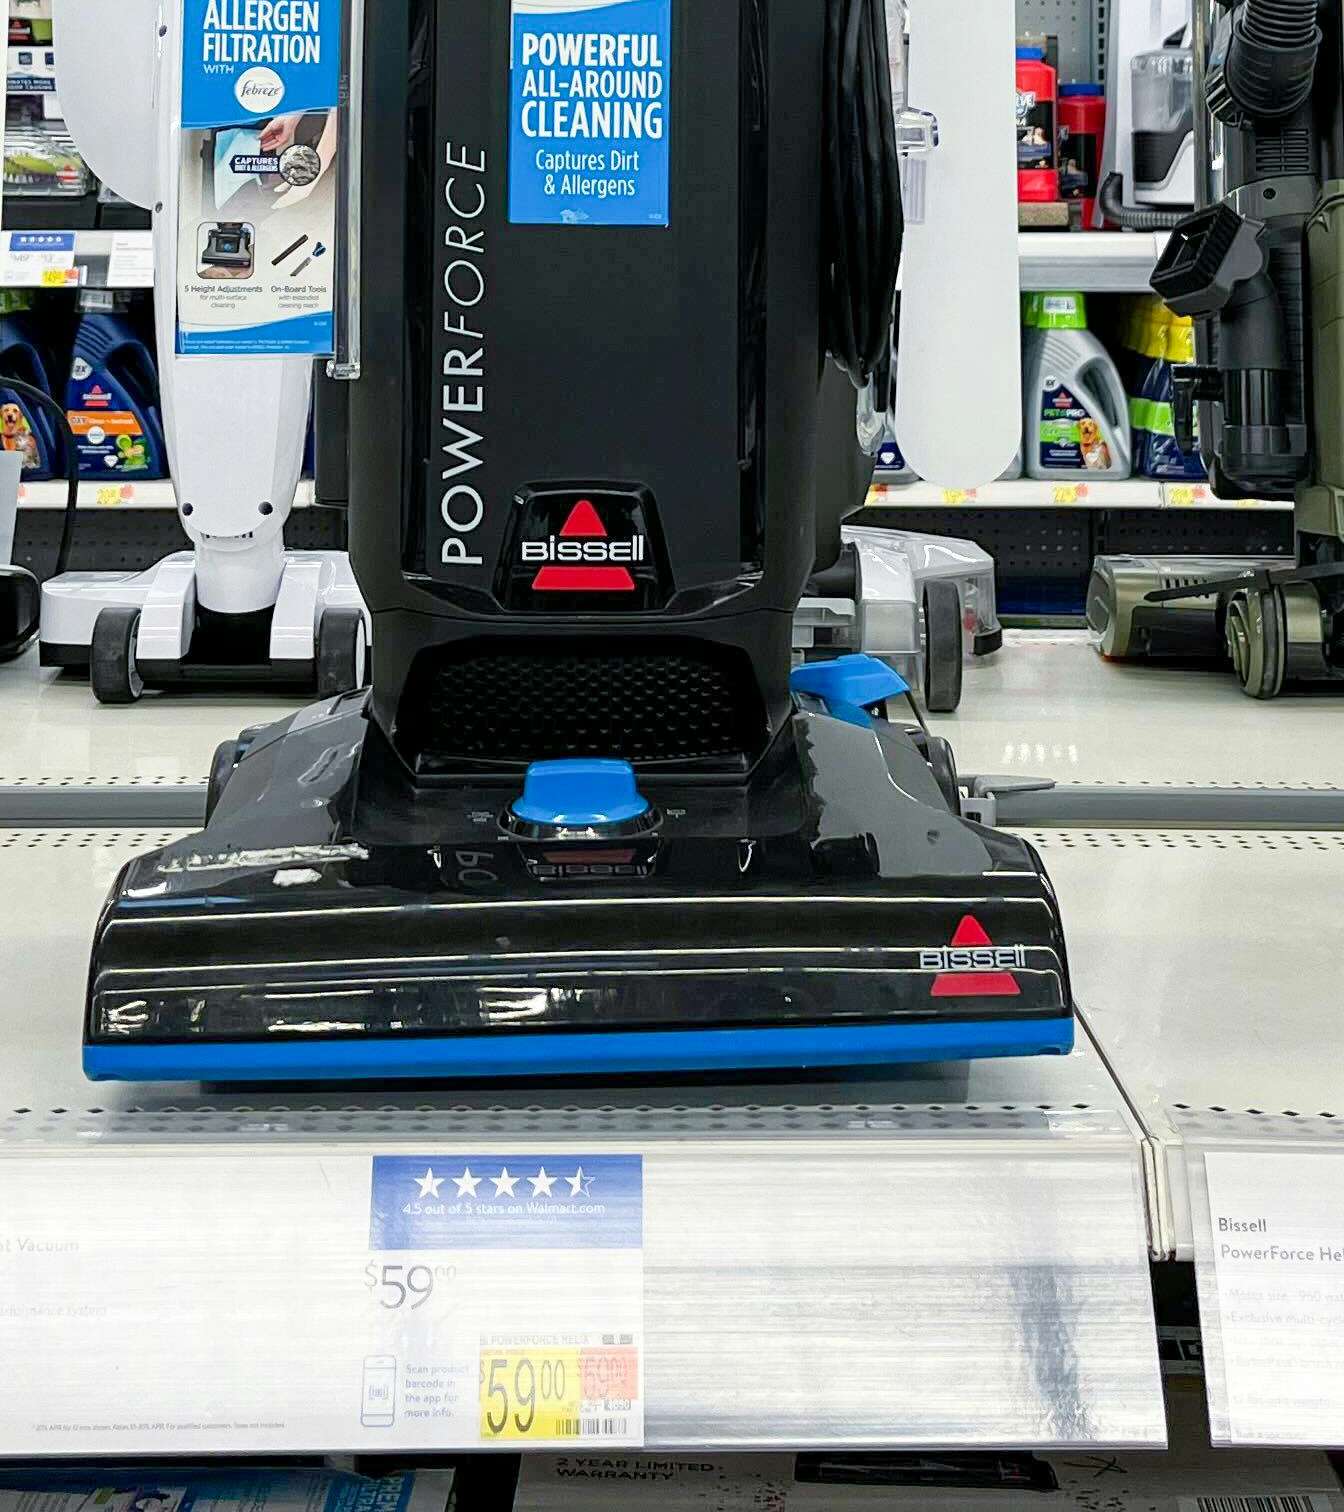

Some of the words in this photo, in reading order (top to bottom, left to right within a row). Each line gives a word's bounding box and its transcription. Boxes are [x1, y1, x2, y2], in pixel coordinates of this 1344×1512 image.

[203, 0, 321, 34] ALLERGEN
[203, 33, 322, 65] FILTRATION
[521, 31, 664, 69] POWERFUL
[203, 64, 235, 76] WITH
[521, 68, 664, 100] ALL-AROUND
[521, 100, 664, 140] CLEANING
[234, 156, 279, 166] CAPTURES
[535, 148, 606, 174] Captures
[610, 148, 641, 172] Dirt
[544, 174, 557, 196] &
[558, 174, 637, 200] Allergens
[440, 141, 487, 566] POWERFORCE
[522, 533, 645, 562] BISSELL
[919, 943, 1028, 971] BISSELL
[402, 1203, 422, 1215] 4.5
[423, 1204, 445, 1215] out
[474, 1204, 506, 1215] stars
[507, 1204, 523, 1215] on
[525, 1202, 606, 1215] Walmart.com
[1218, 1217, 1268, 1233] Bissell
[16, 1238, 81, 1254] Vacuum
[1220, 1244, 1315, 1262] PowerForce
